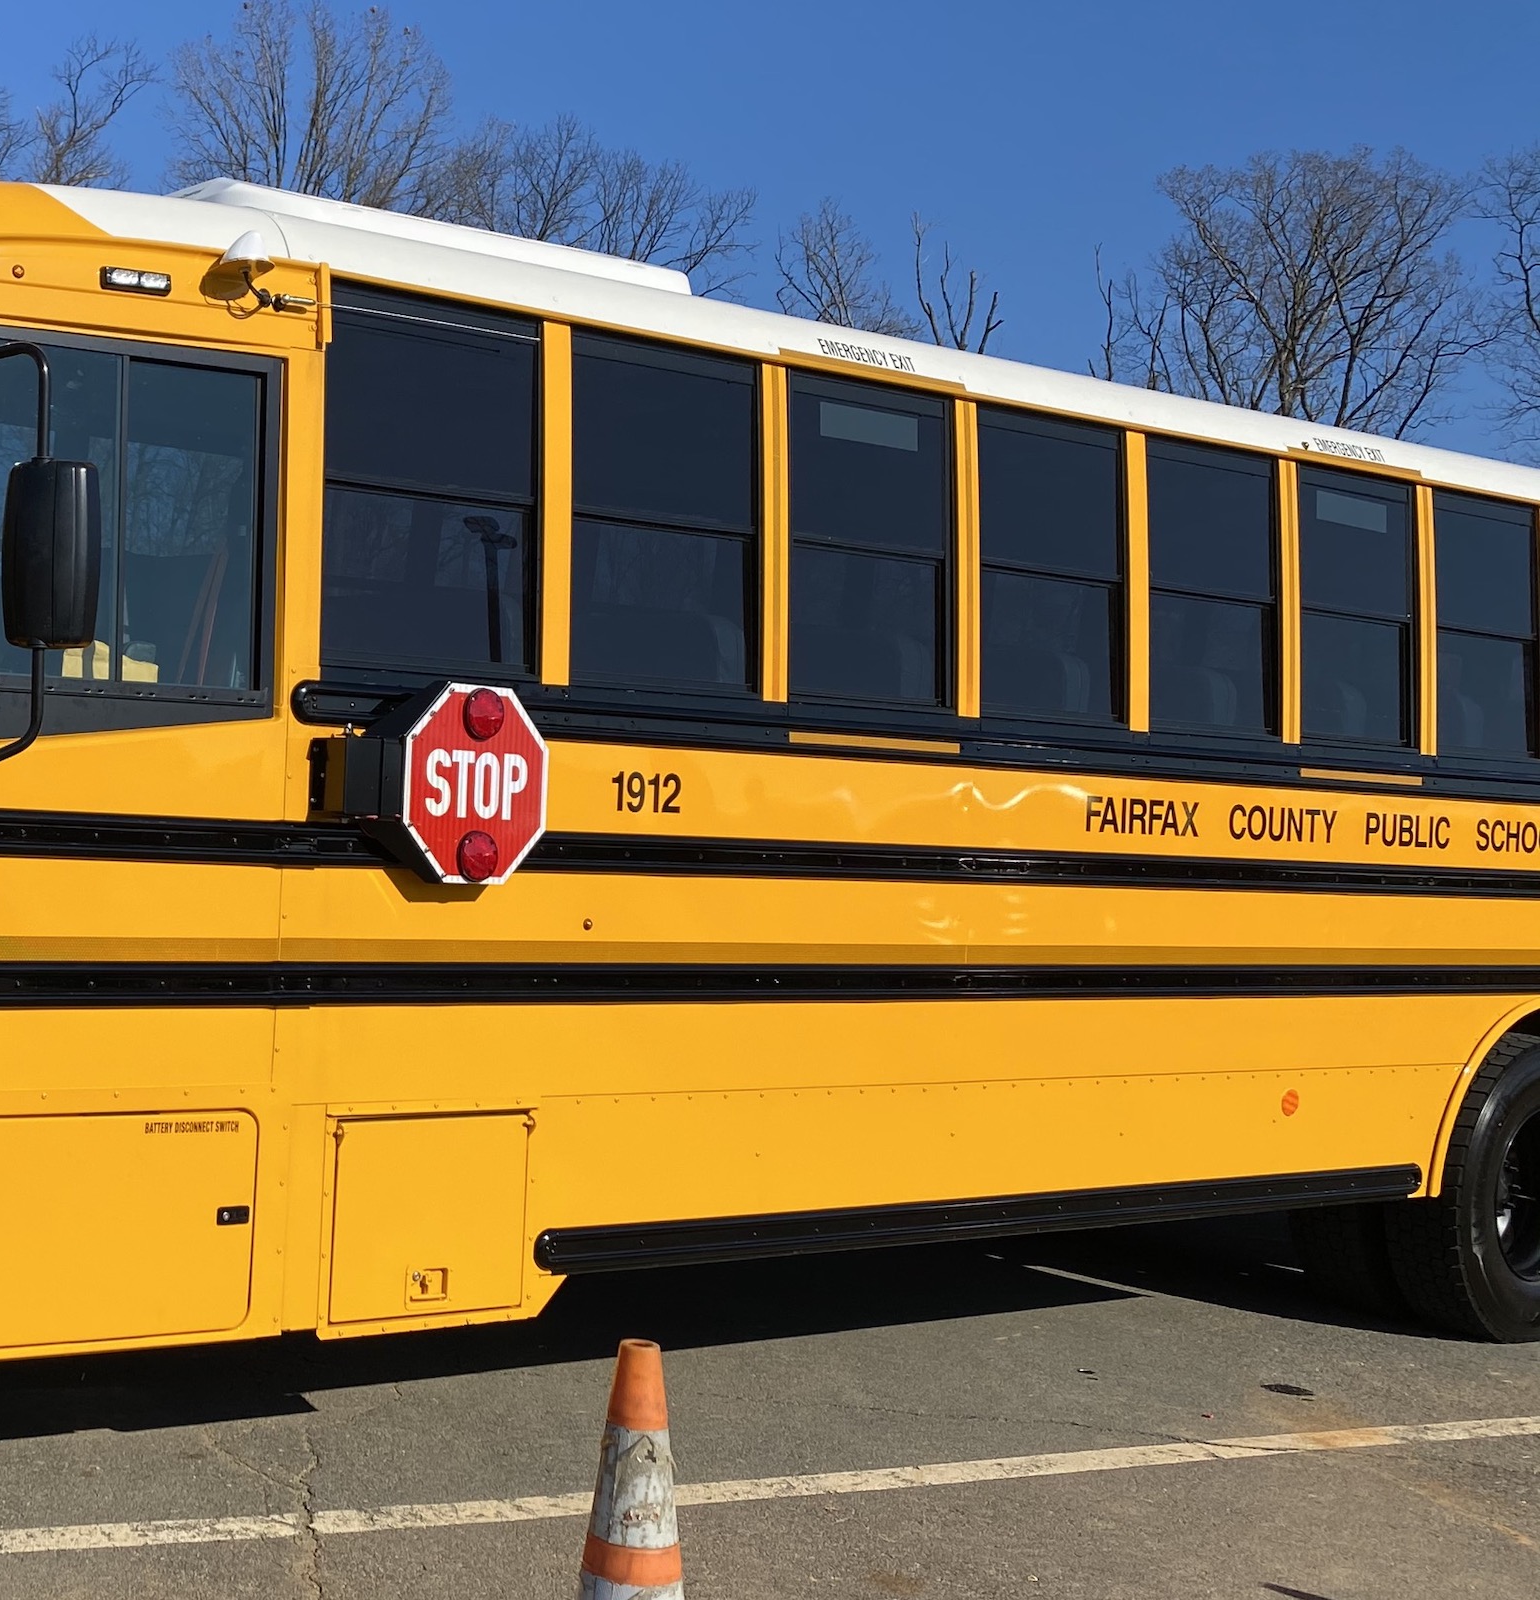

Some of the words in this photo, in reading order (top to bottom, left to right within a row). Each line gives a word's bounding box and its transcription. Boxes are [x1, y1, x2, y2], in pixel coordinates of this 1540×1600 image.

[816, 338, 888, 367] EMERGENCY
[889, 352, 916, 372] EXIT
[1312, 437, 1366, 459] EMERGENCY
[1364, 446, 1386, 463] EXIT
[424, 748, 528, 821] STOP
[611, 771, 682, 813] 1912
[1085, 795, 1200, 838] FAIRFAX
[1228, 804, 1338, 844] COUNTY
[1364, 812, 1451, 849] PUBLIC
[1475, 818, 1540, 854] SCHO
[144, 1122, 173, 1134] BATTERY
[174, 1121, 214, 1134] DISCONNECT
[215, 1120, 240, 1133] SWITCH
